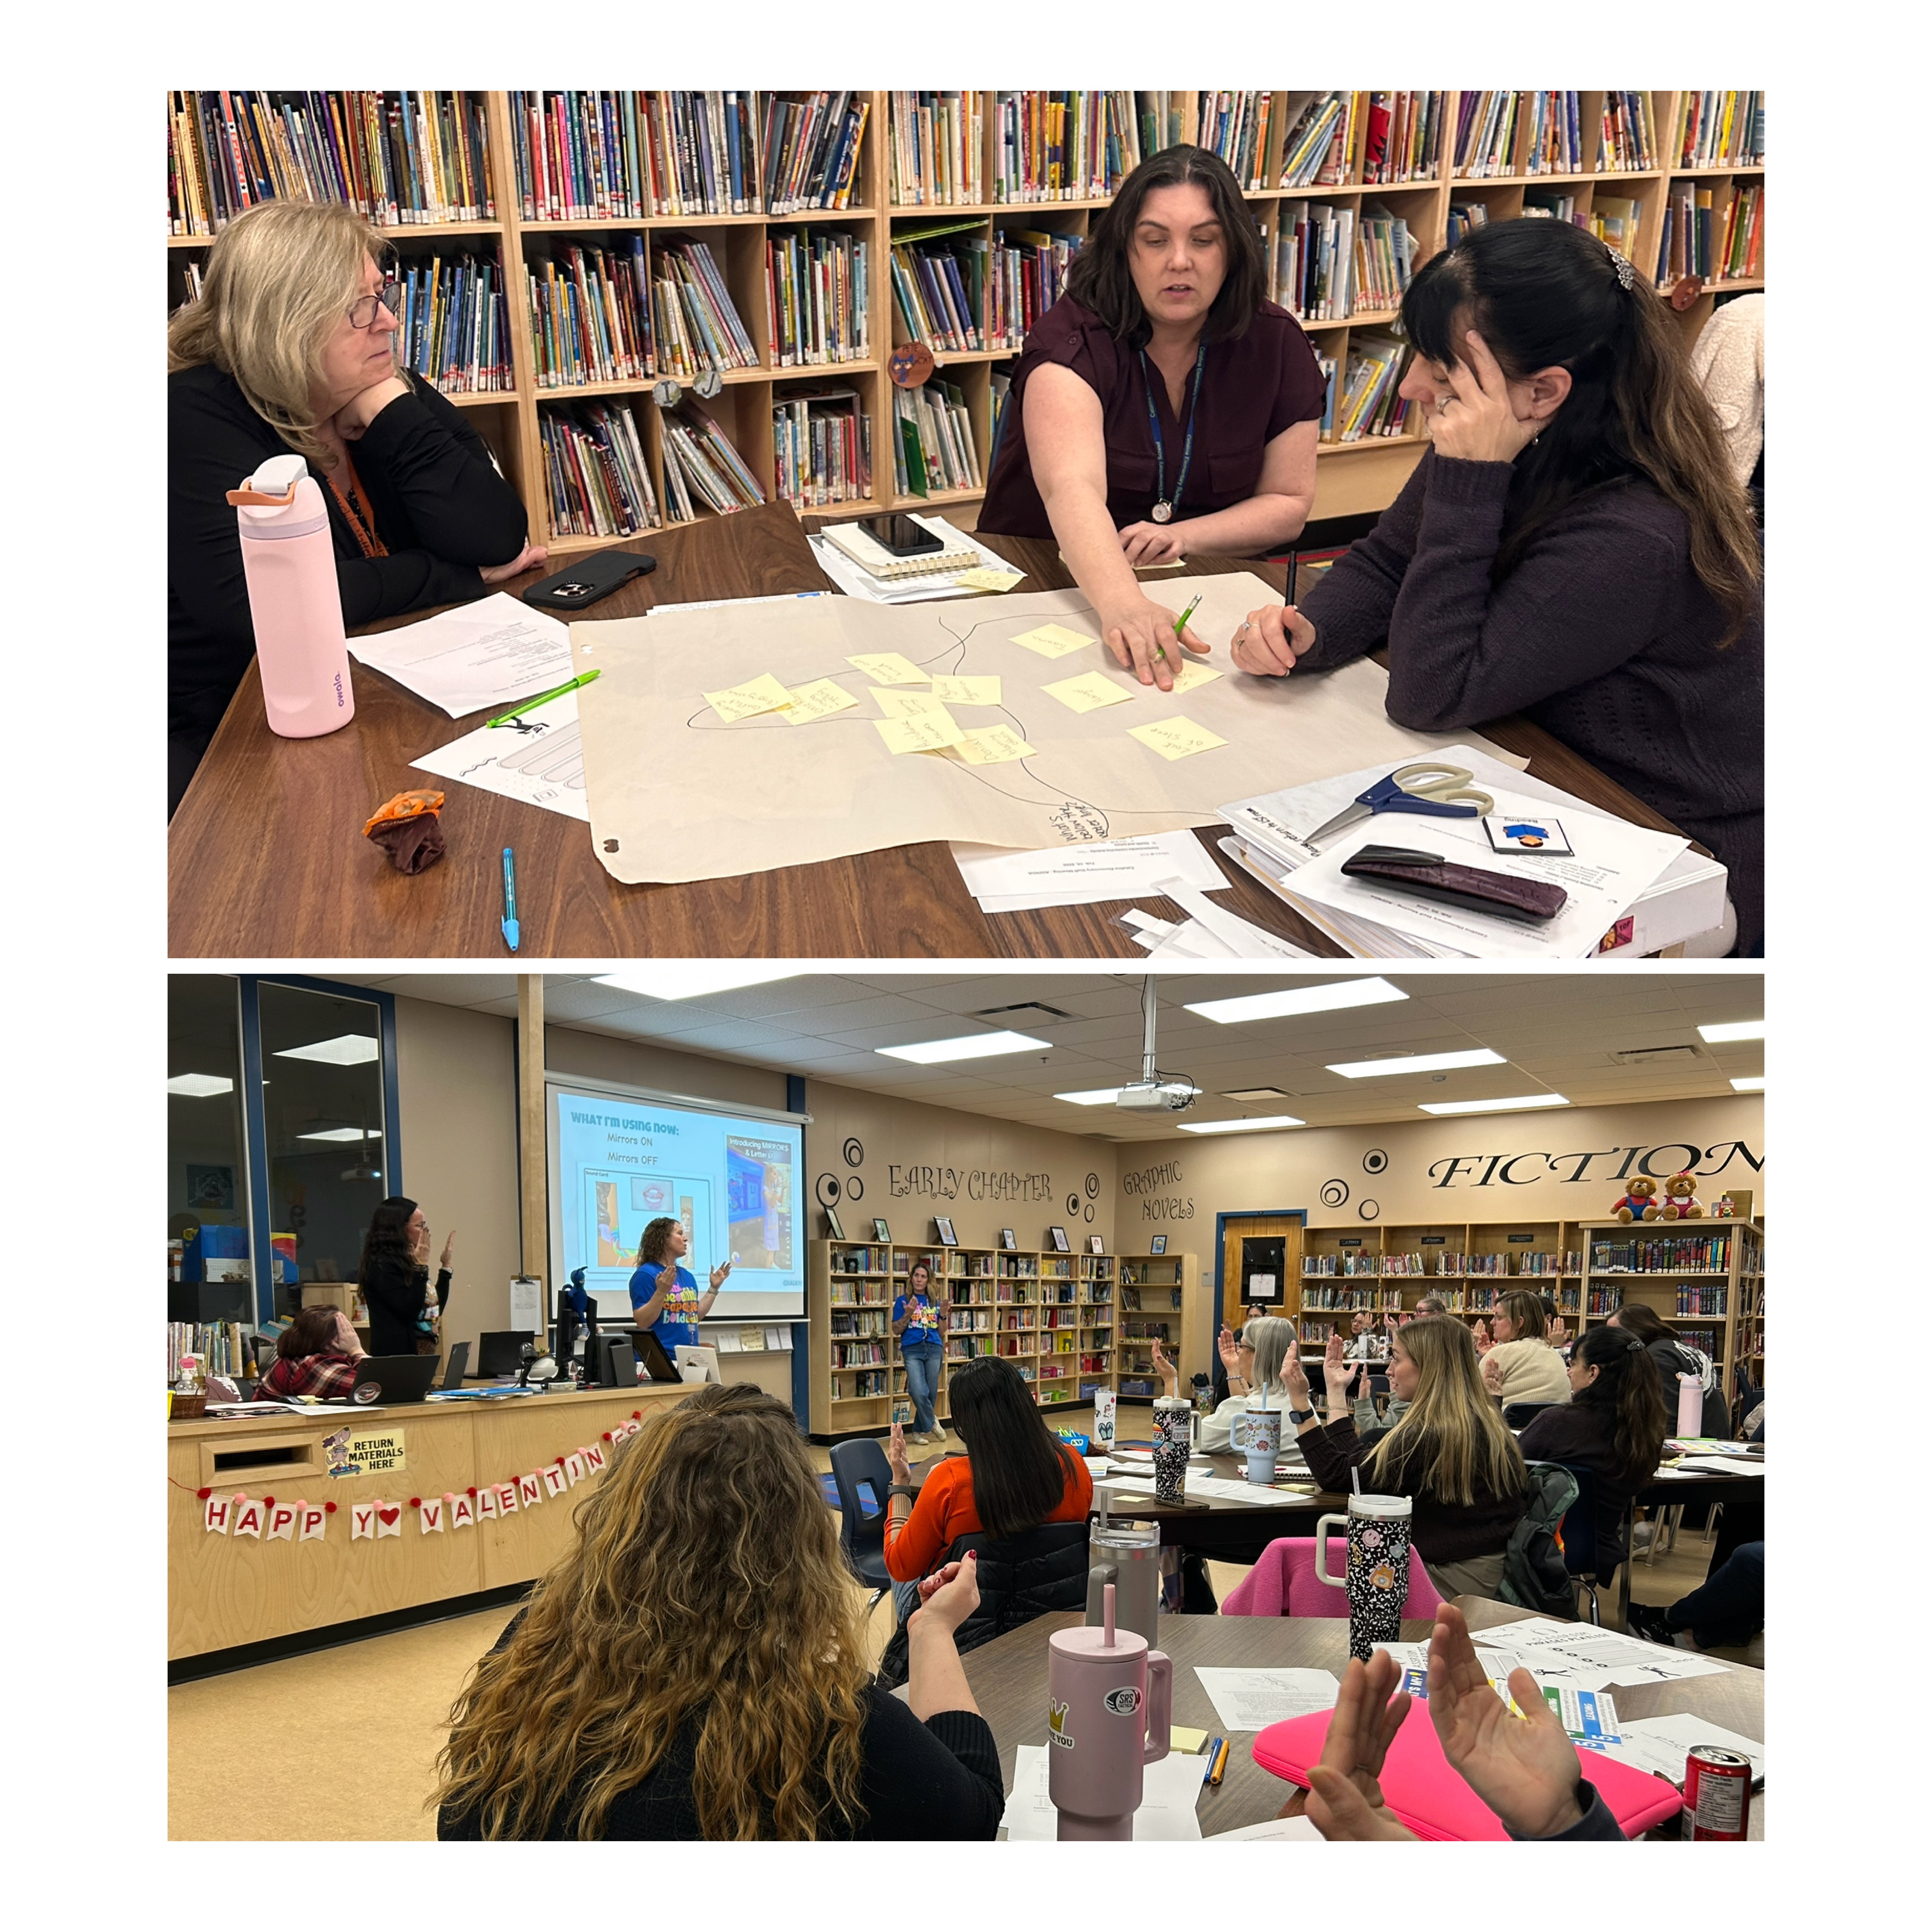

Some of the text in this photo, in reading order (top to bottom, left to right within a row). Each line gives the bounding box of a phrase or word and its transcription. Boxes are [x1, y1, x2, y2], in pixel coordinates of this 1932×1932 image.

[702, 373, 715, 394] J
[662, 381, 672, 403] I
[333, 671, 344, 707] owala
[1277, 828, 1302, 842] return
[571, 1111, 602, 1125] WHAT
[607, 1133, 653, 1146] Mirrors ON
[729, 1138, 789, 1152] Introducing MIRRORS
[608, 1152, 658, 1165] Mirrors OFF
[1428, 1140, 1764, 1189] FICTION
[888, 1165, 1053, 1203] EARLY CHAPTER
[1123, 1161, 1183, 1195] GRAPHIC
[1142, 1197, 1194, 1221] NOVELS
[354, 1438, 394, 1451] RETURN
[349, 1448, 403, 1462] MATERIALS
[369, 1459, 395, 1470] HERE
[1119, 1693, 1134, 1704] SRS
[1583, 1703, 1596, 1720] LEADING
[1056, 1734, 1073, 1747] YOU
